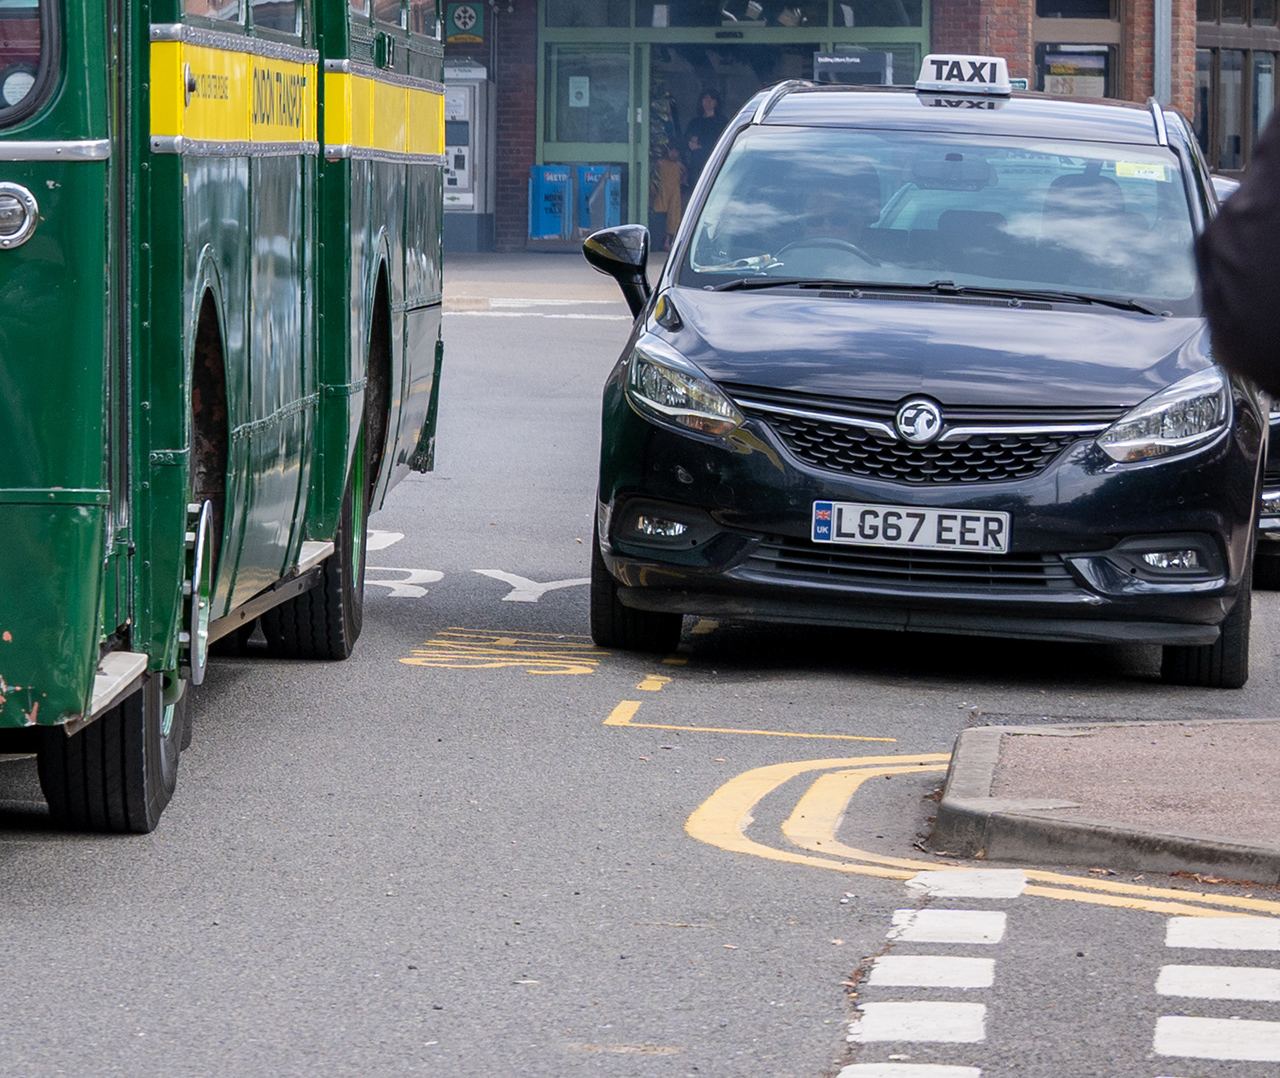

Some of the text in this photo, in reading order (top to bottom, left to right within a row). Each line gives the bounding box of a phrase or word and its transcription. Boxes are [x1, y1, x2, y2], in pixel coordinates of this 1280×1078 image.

[930, 59, 997, 83] TAXI
[251, 67, 275, 125] ONDON
[276, 71, 306, 128] TRANSPOT
[816, 525, 829, 534] UK
[835, 507, 1004, 548] LG67 EER
